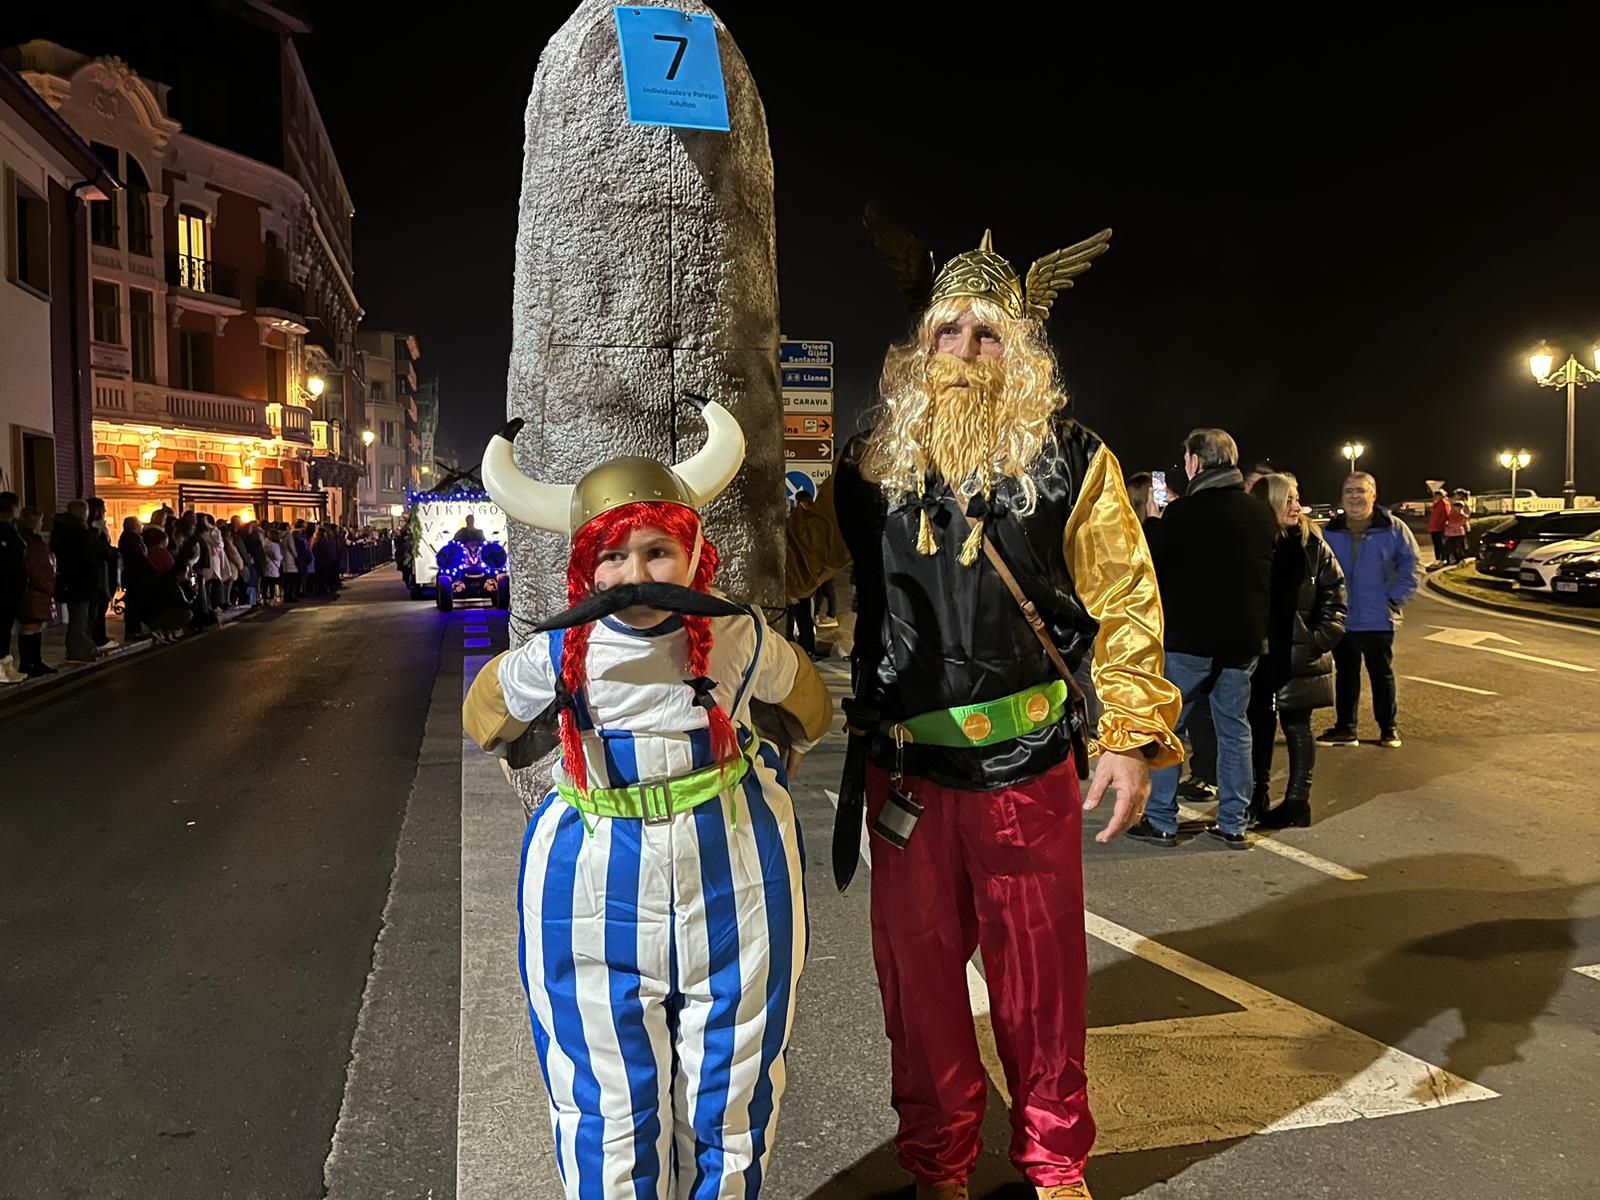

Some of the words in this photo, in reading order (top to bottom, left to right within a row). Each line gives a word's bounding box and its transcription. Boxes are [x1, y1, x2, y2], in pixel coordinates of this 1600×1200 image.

[653, 34, 688, 80] 7
[643, 87, 686, 96] Individuales
[693, 91, 718, 100] Parejas
[669, 100, 696, 108] Adultos
[793, 398, 828, 406] CARAVIA
[422, 505, 505, 516] VIKINGO
